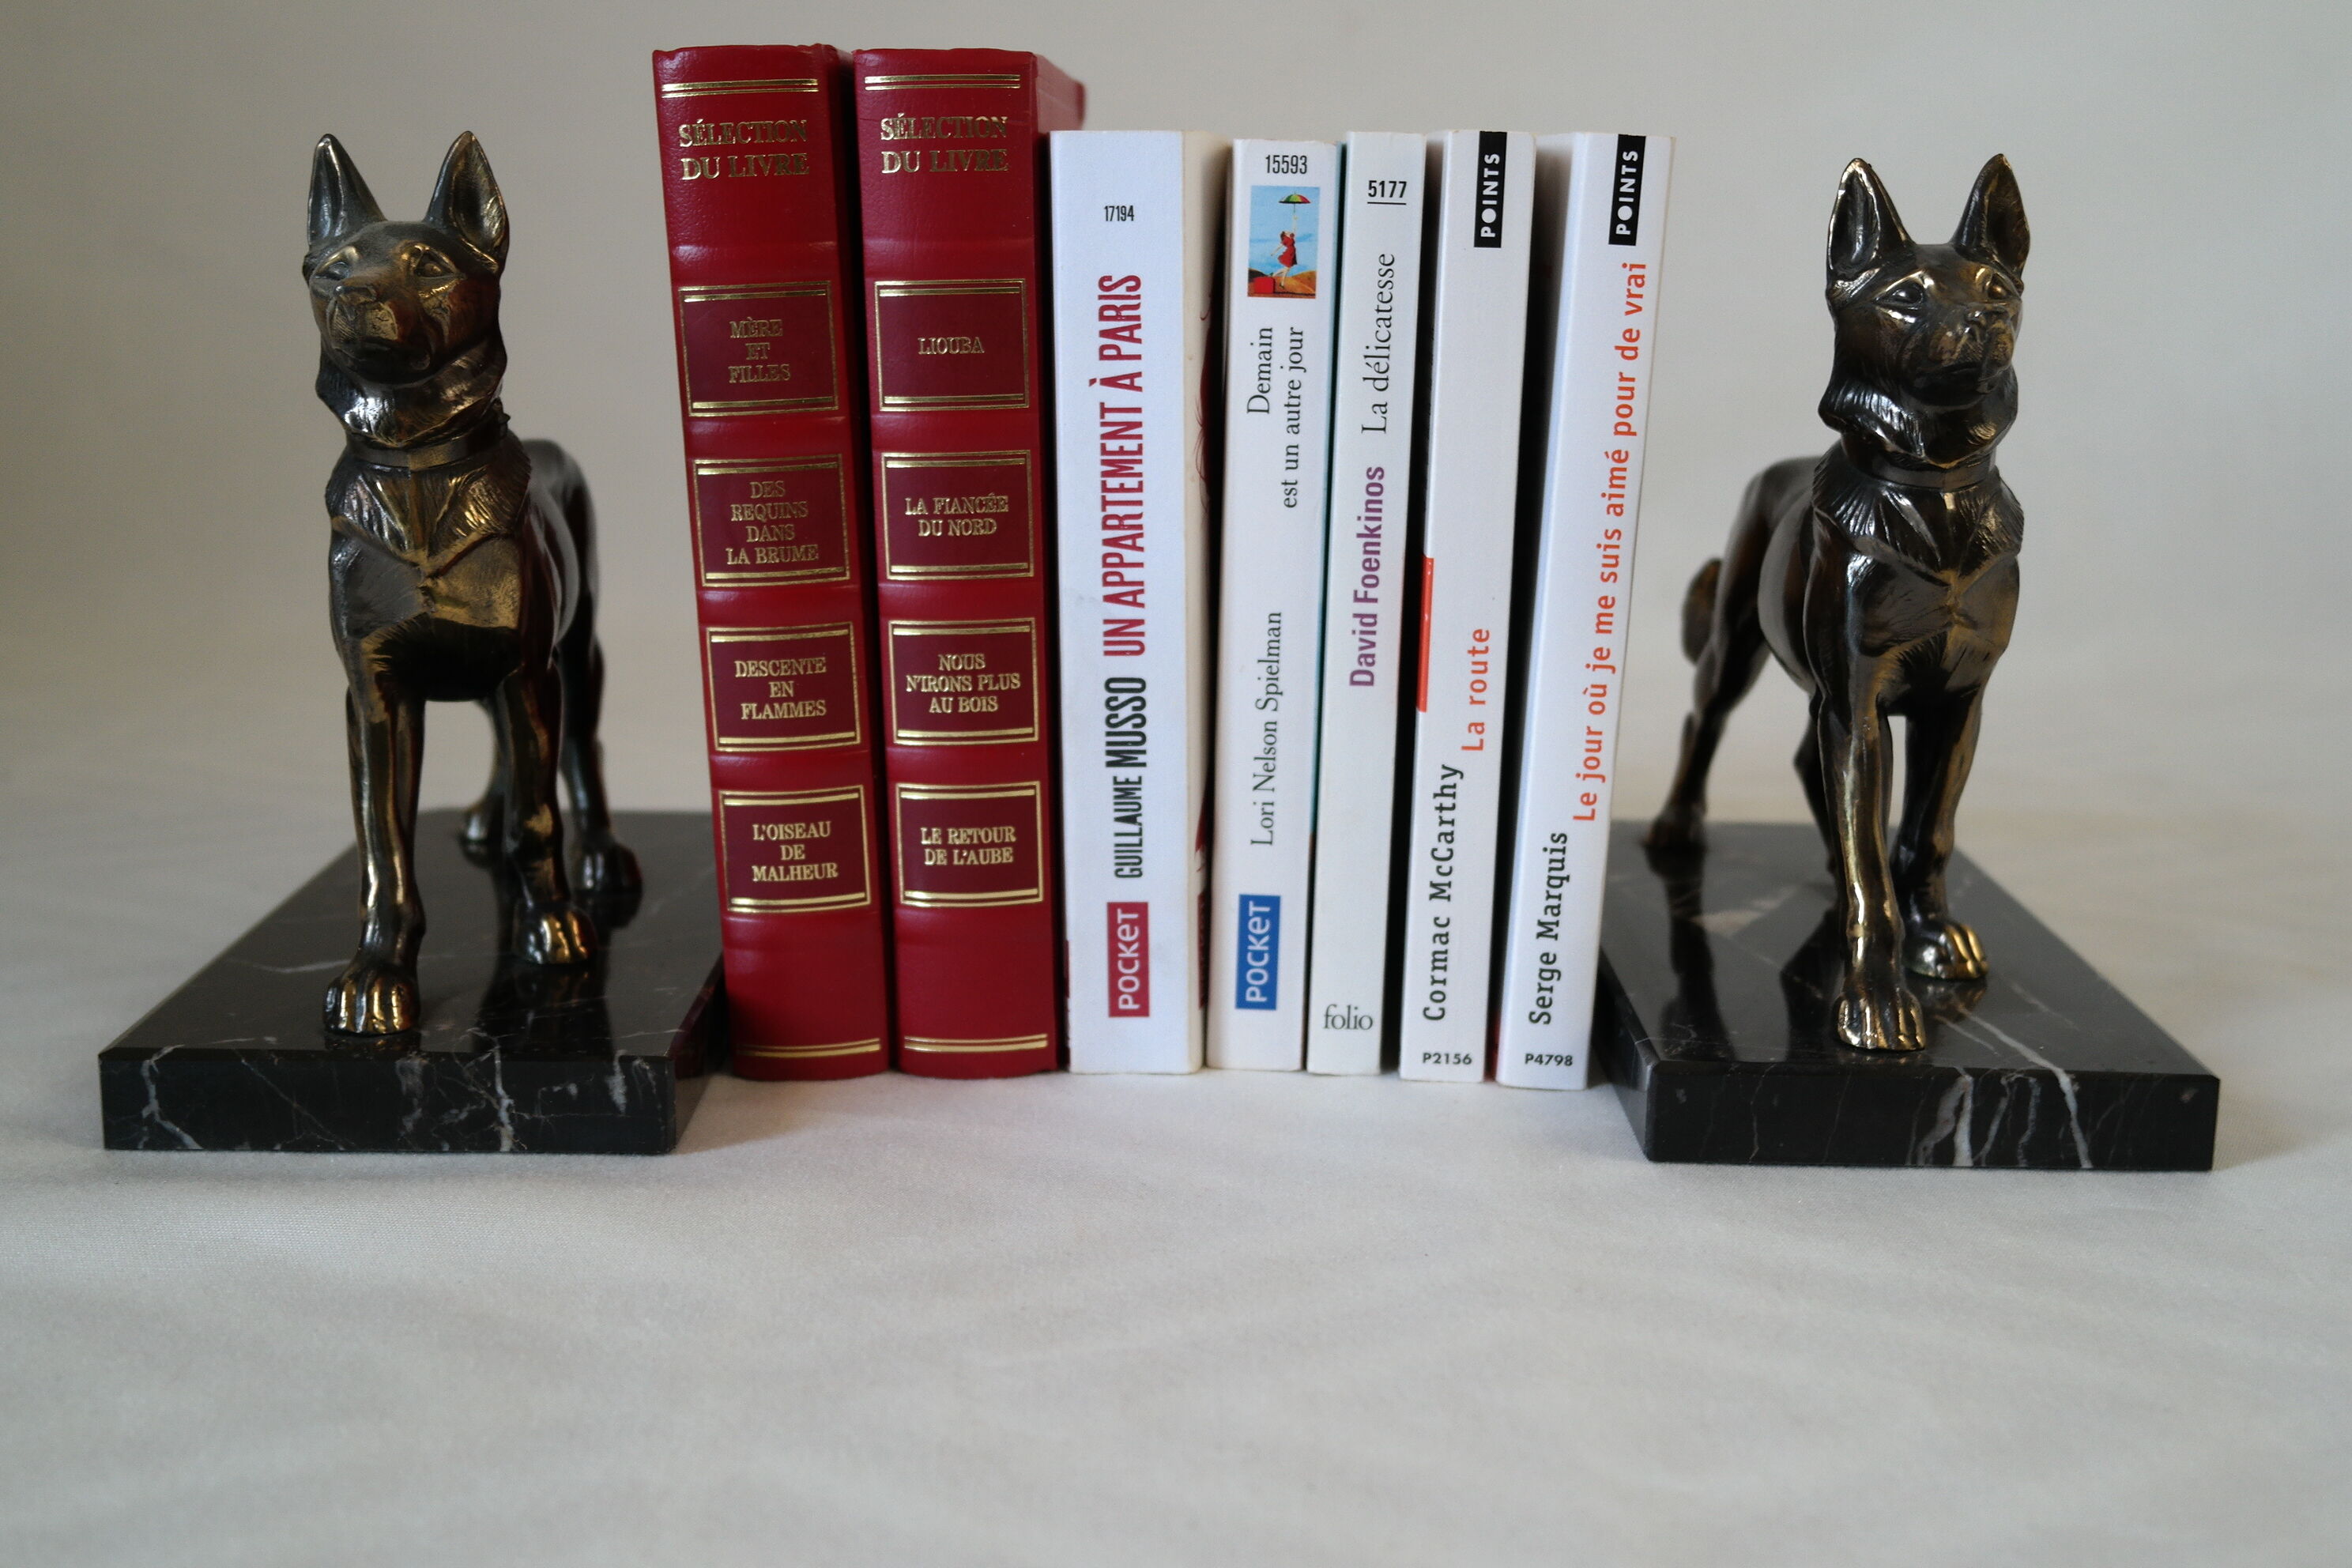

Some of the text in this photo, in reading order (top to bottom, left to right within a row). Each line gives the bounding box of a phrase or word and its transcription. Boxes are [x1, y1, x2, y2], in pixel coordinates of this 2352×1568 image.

[679, 119, 808, 148] SÉLECTION
[880, 113, 1008, 140] SÉLECTION
[681, 153, 810, 180] DU LIVRE
[882, 149, 1008, 174] DU LIVRE
[1265, 155, 1308, 175] 15593
[1367, 180, 1408, 199] 5177
[1480, 153, 1500, 238] POINTS
[1615, 150, 1638, 235] POINTS
[1104, 205, 1135, 222] 17194
[730, 317, 782, 338] MÈRE
[746, 342, 770, 361] ET
[918, 337, 985, 356] LIOUBA
[1362, 253, 1395, 433] La délicatesse
[729, 364, 791, 383] FILLES
[1246, 326, 1273, 414] Demain
[1280, 327, 1307, 508] est un autre jour
[1088, 275, 1145, 657] UN APPARTEMENT À PARIS
[750, 481, 786, 499] DES
[731, 501, 808, 522] REQUINS
[905, 492, 1008, 515] LA FIANCÉE
[746, 524, 795, 542] DANS
[918, 518, 997, 537] DU NORD
[1573, 262, 1646, 821] Le jour où je me suis aimé pour de vrai
[726, 544, 819, 565] LA BRUME
[1349, 466, 1385, 686] David Foenkinos
[735, 657, 827, 678] DESCENTE
[938, 654, 986, 671] NOUS
[769, 680, 794, 698] EN
[906, 673, 1021, 693] N'IRONS PLUS
[1461, 628, 1491, 752] La route
[741, 700, 827, 720] FLAMMES
[929, 695, 998, 714] AU BOIS
[1250, 612, 1283, 846] Lori Nelson Spielman
[1104, 677, 1147, 879] GUILLAUME MUSSO
[752, 821, 831, 841] L'OISEAU
[921, 826, 1016, 845] LE RETOUR
[780, 844, 805, 861] DE
[925, 846, 1013, 865] DE L'AUBE
[752, 862, 839, 882] MALHEUR
[1423, 763, 1464, 1021] Cormac McCarthy
[1528, 831, 1570, 1024] Serge Marquis
[1323, 1004, 1373, 1031] folio
[1423, 1053, 1472, 1065] P2156
[1525, 1054, 1574, 1066] P4798
